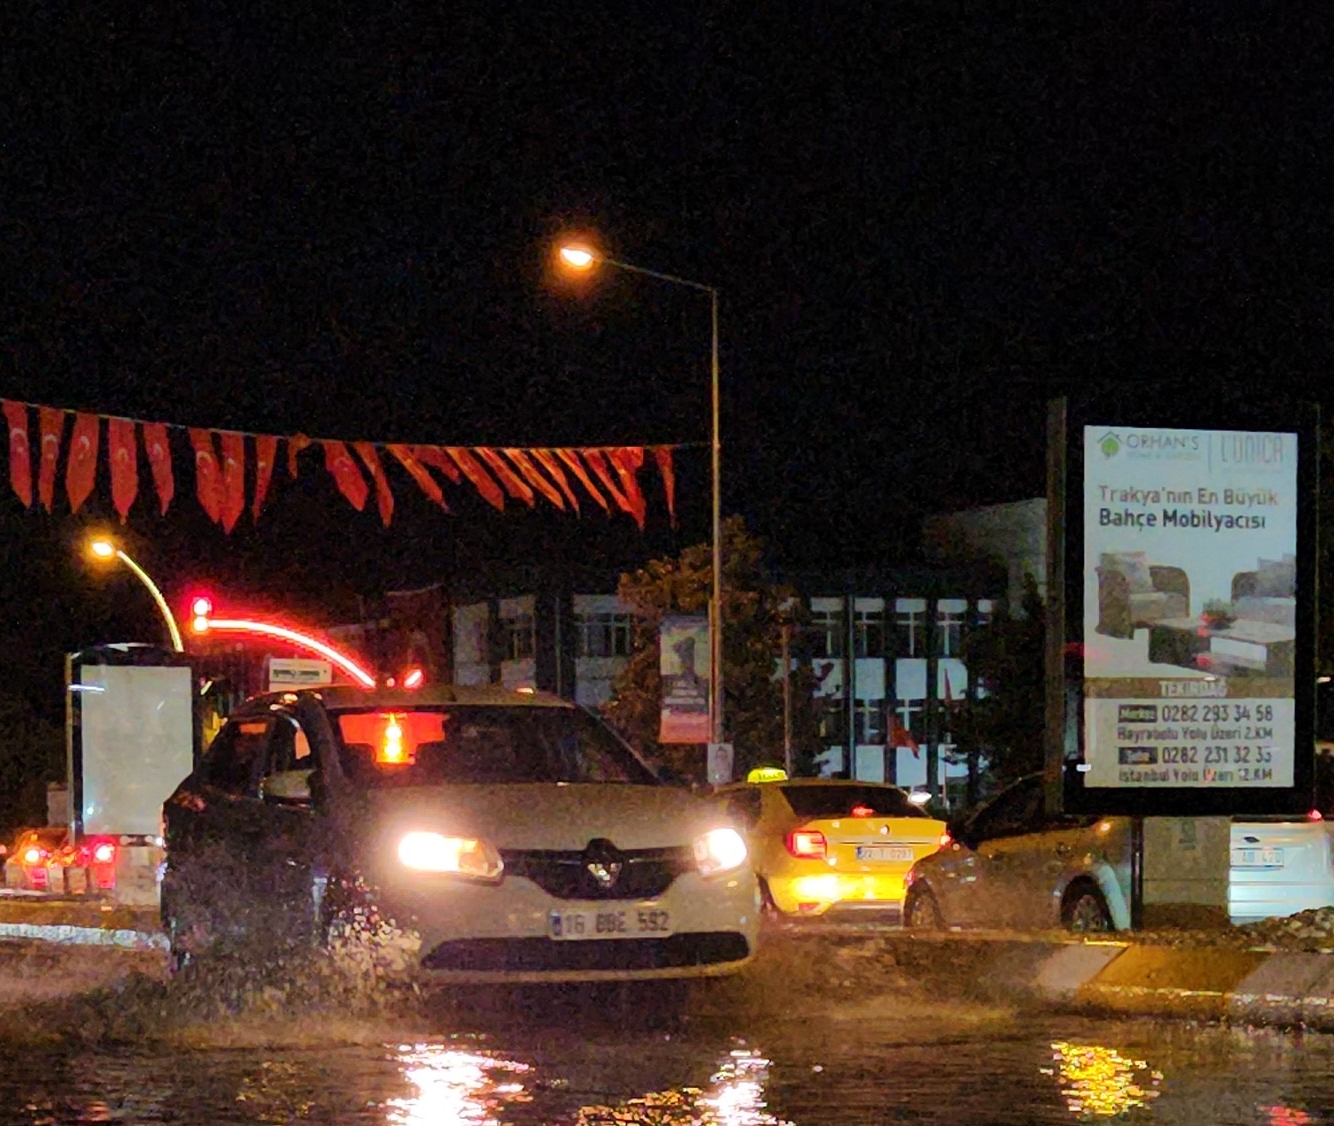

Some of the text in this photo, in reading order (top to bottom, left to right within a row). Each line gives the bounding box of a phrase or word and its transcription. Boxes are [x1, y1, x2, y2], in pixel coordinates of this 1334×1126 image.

[1126, 434, 1200, 450] ORHAN'S
[1098, 485, 1279, 509] Trakya'nın En Büyük
[1099, 508, 1266, 532] Bahçe Mobilyacısı
[1162, 705, 1198, 722] 0282
[1203, 705, 1229, 722] 293
[1233, 705, 1251, 722] 34
[1256, 705, 1273, 722] 58
[1181, 727, 1207, 741] Yolu
[1162, 747, 1198, 763] 0282
[1204, 746, 1228, 763] 231
[1233, 746, 1251, 763] 32
[565, 914, 585, 934] 16
